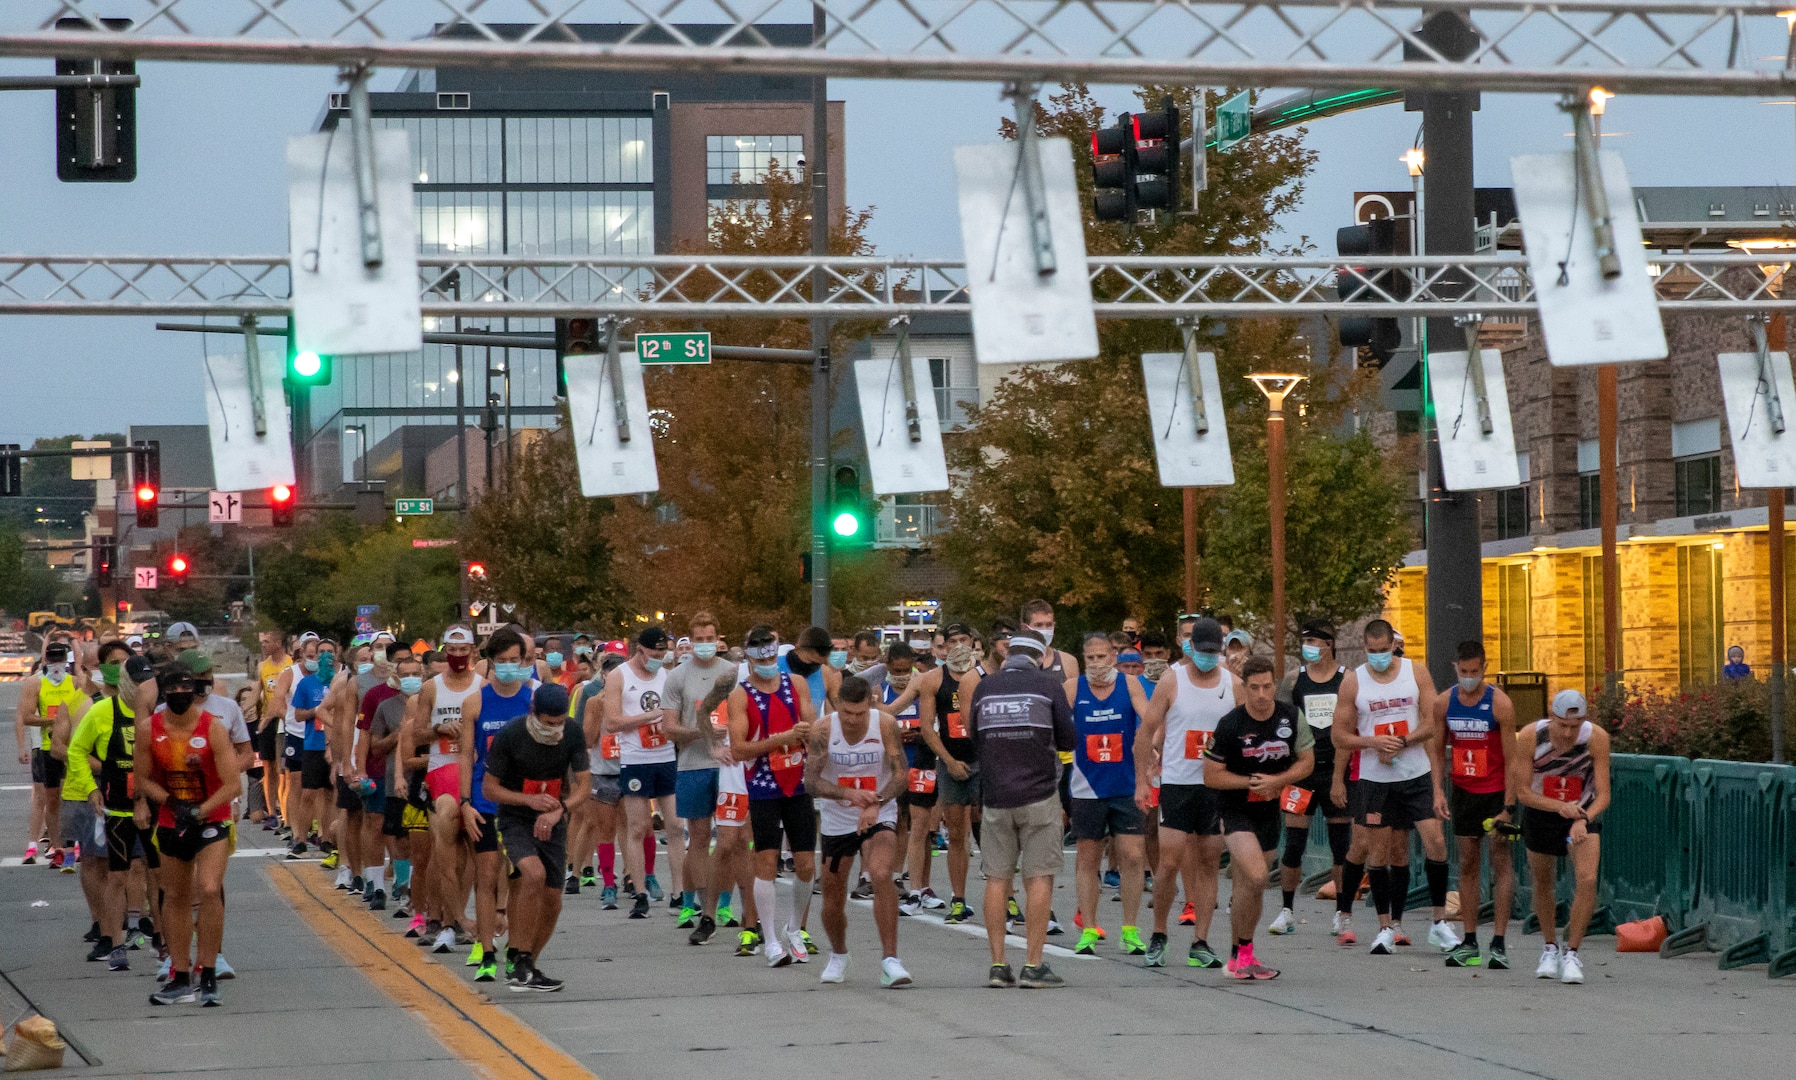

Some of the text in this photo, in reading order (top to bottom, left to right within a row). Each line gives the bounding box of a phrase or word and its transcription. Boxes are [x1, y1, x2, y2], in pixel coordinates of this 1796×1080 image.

[641, 339, 705, 358] 12th St
[419, 502, 431, 511] St
[1465, 766, 1476, 776] 12
